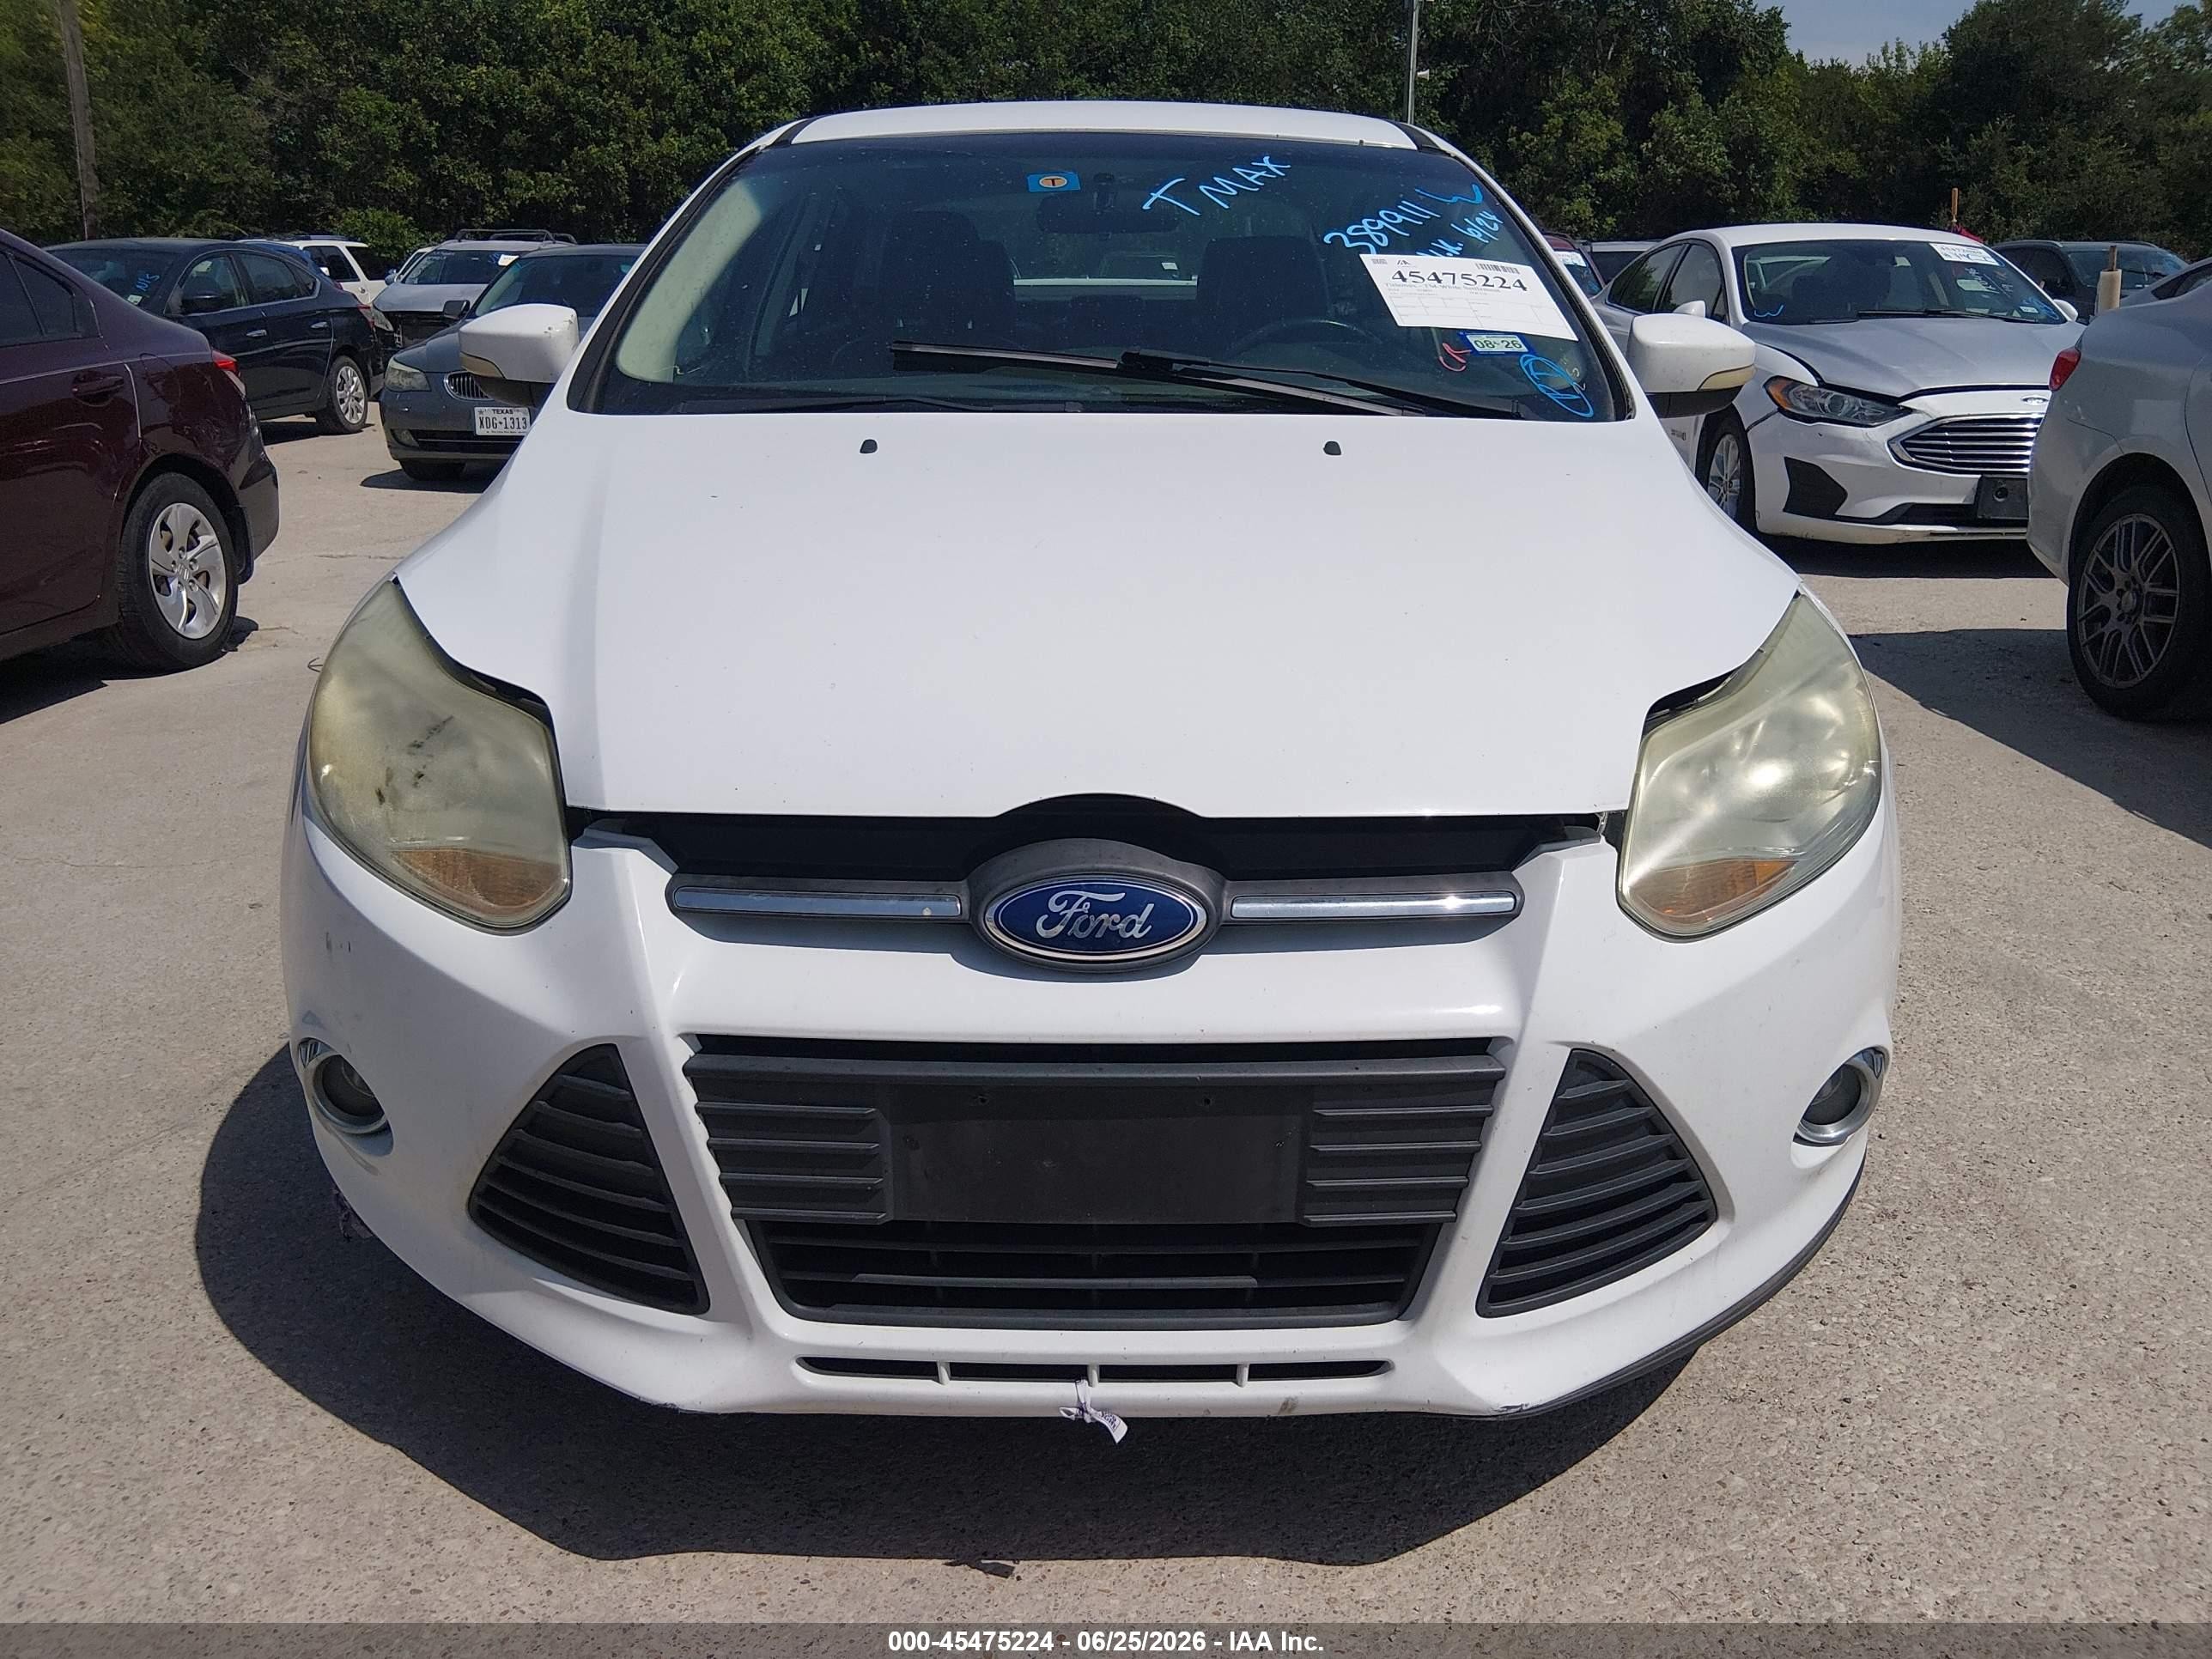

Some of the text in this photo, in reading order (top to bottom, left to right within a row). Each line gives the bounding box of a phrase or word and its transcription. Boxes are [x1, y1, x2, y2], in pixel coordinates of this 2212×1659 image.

[1142, 155, 1291, 216] T MAX
[1391, 270, 1528, 292] 45475224
[1474, 339, 1522, 349] 08 26
[1036, 890, 1155, 939] Ford
